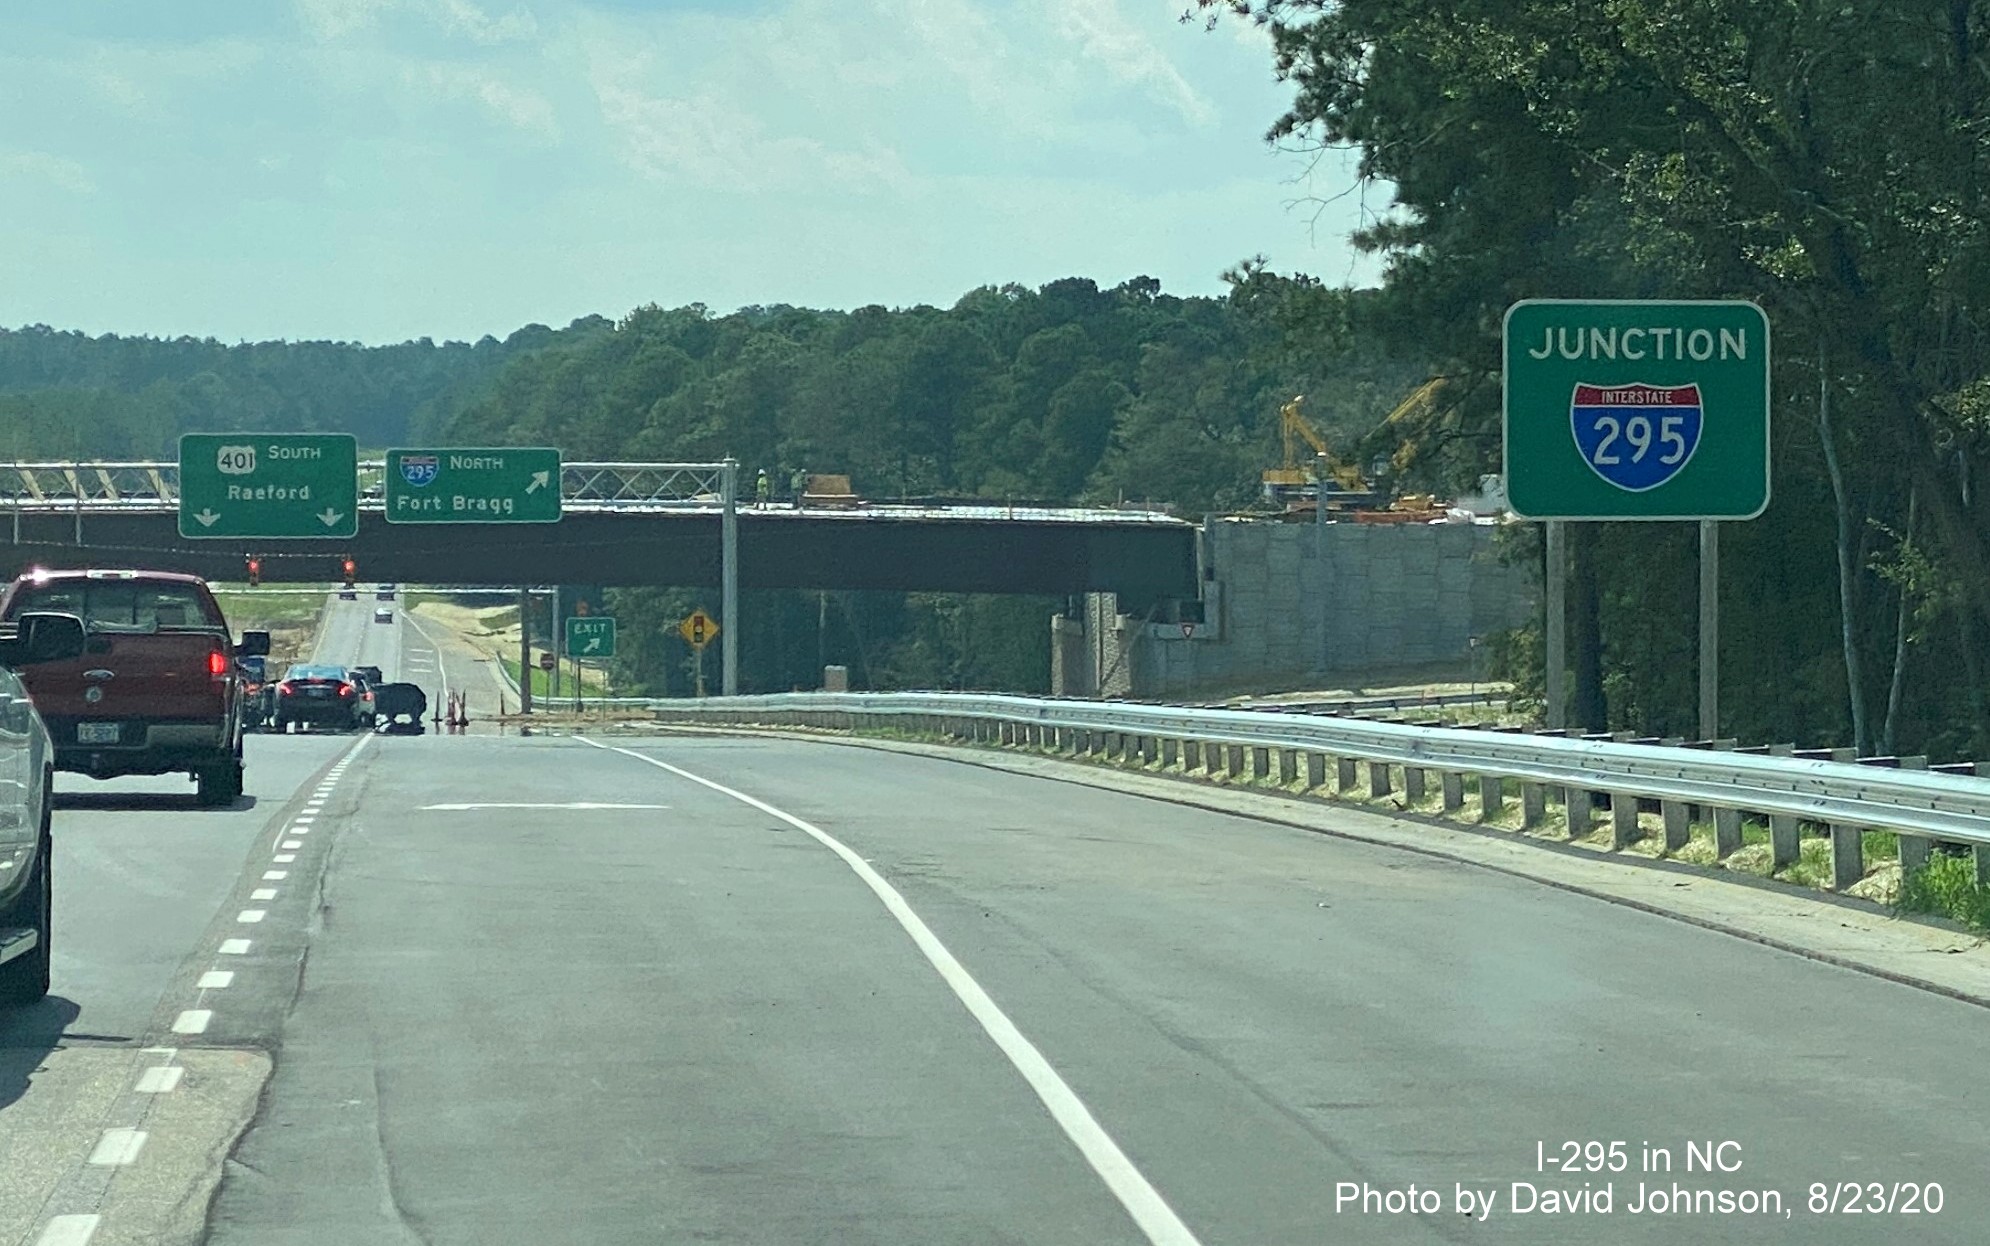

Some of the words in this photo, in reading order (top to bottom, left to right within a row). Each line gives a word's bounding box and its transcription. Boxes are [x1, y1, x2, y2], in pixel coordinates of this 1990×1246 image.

[1528, 327, 1747, 361] JUNCTION
[1601, 391, 1673, 404] INTERSTATE
[1593, 416, 1685, 465] 295
[220, 453, 255, 470] 401
[268, 446, 321, 460] SOUTH
[407, 465, 434, 480] 295
[450, 456, 504, 470] NORTH
[228, 485, 310, 500] Raeford
[397, 496, 442, 511] Fort
[453, 496, 513, 514] Bragg
[574, 623, 606, 635] EXIT
